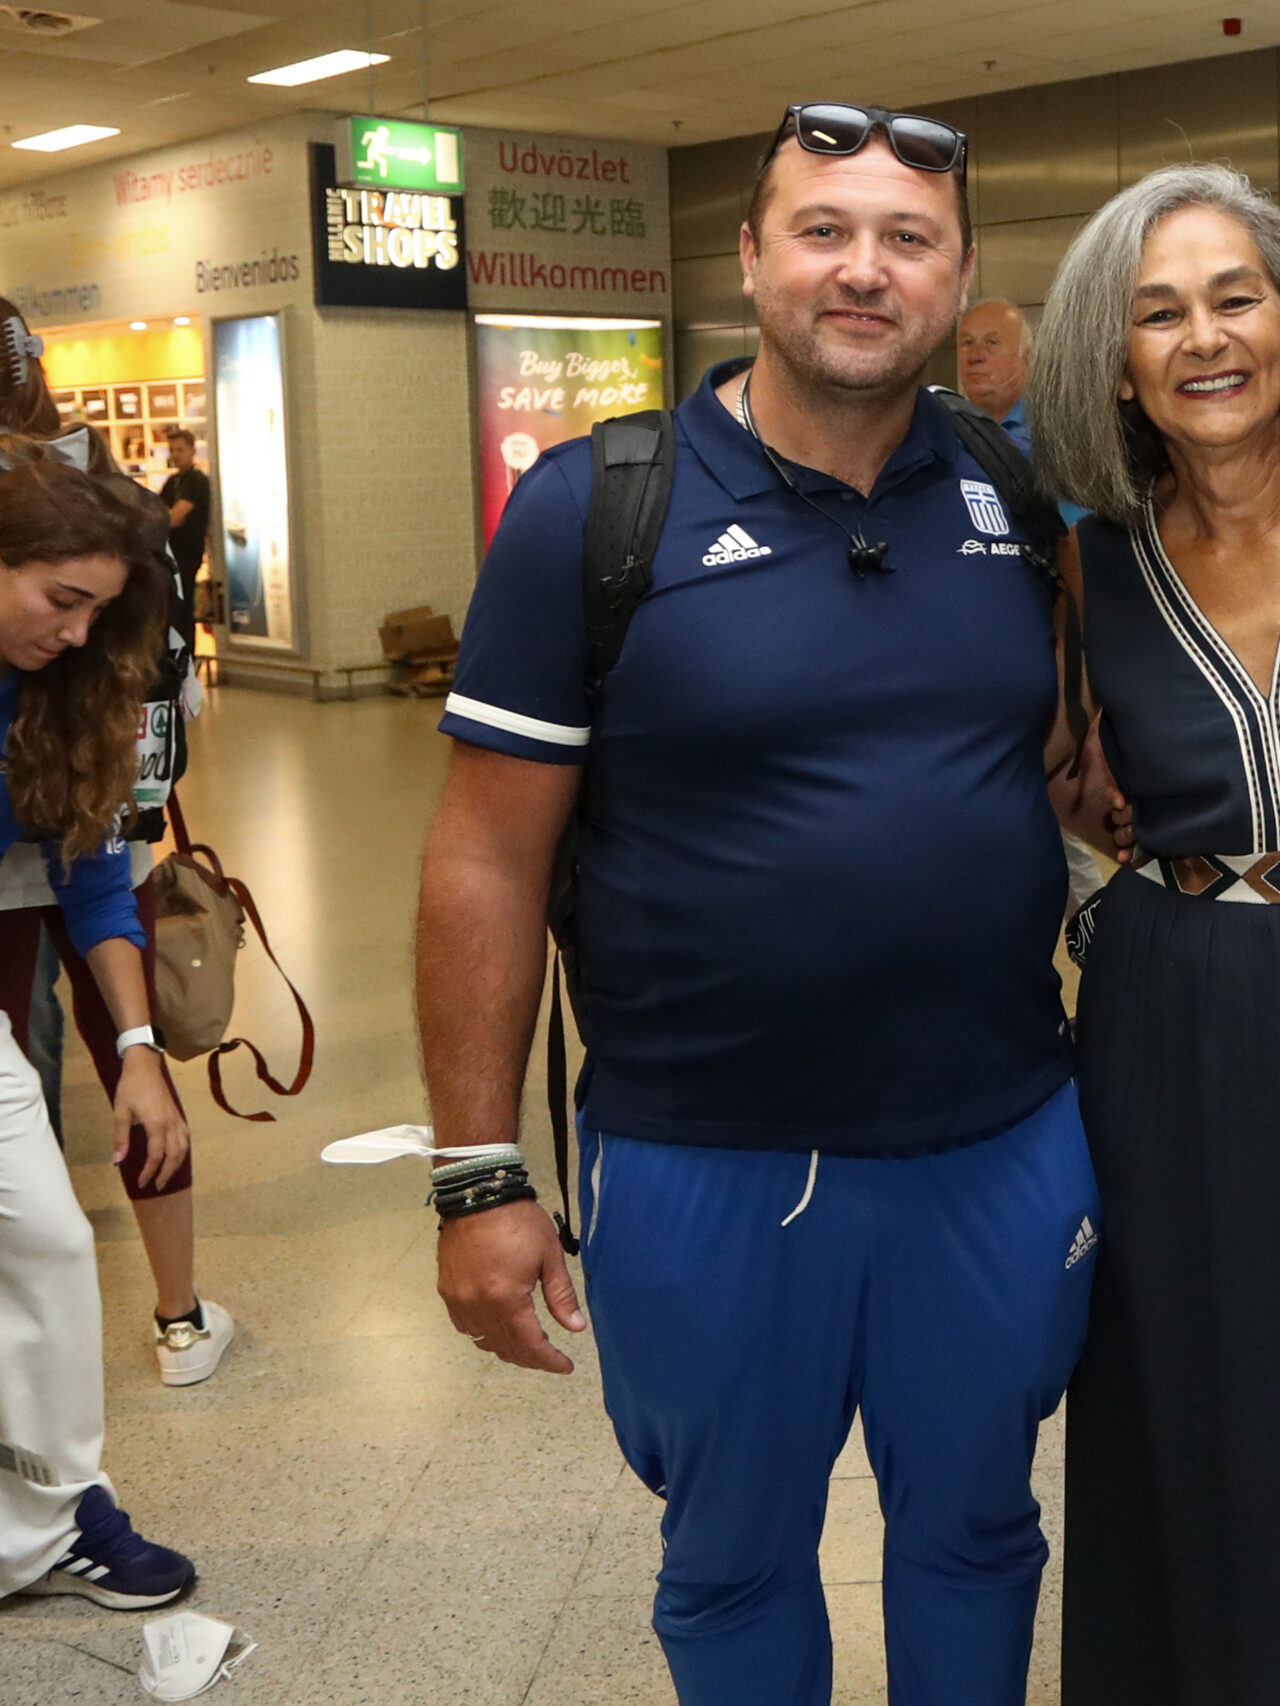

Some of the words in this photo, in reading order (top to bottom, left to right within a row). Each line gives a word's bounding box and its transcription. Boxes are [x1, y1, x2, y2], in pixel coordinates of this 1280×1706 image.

[341, 189, 457, 231] TRAVEL
[488, 186, 646, 238] 歡迎光臨
[343, 225, 459, 271] SHOPS
[196, 248, 299, 294] Bienvenidos
[467, 251, 667, 293] Willkommen
[519, 350, 563, 383] Buy
[497, 386, 566, 411] SAVE
[573, 382, 649, 408] MORE
[702, 546, 772, 567] adidas
[990, 542, 1021, 556] AEGE
